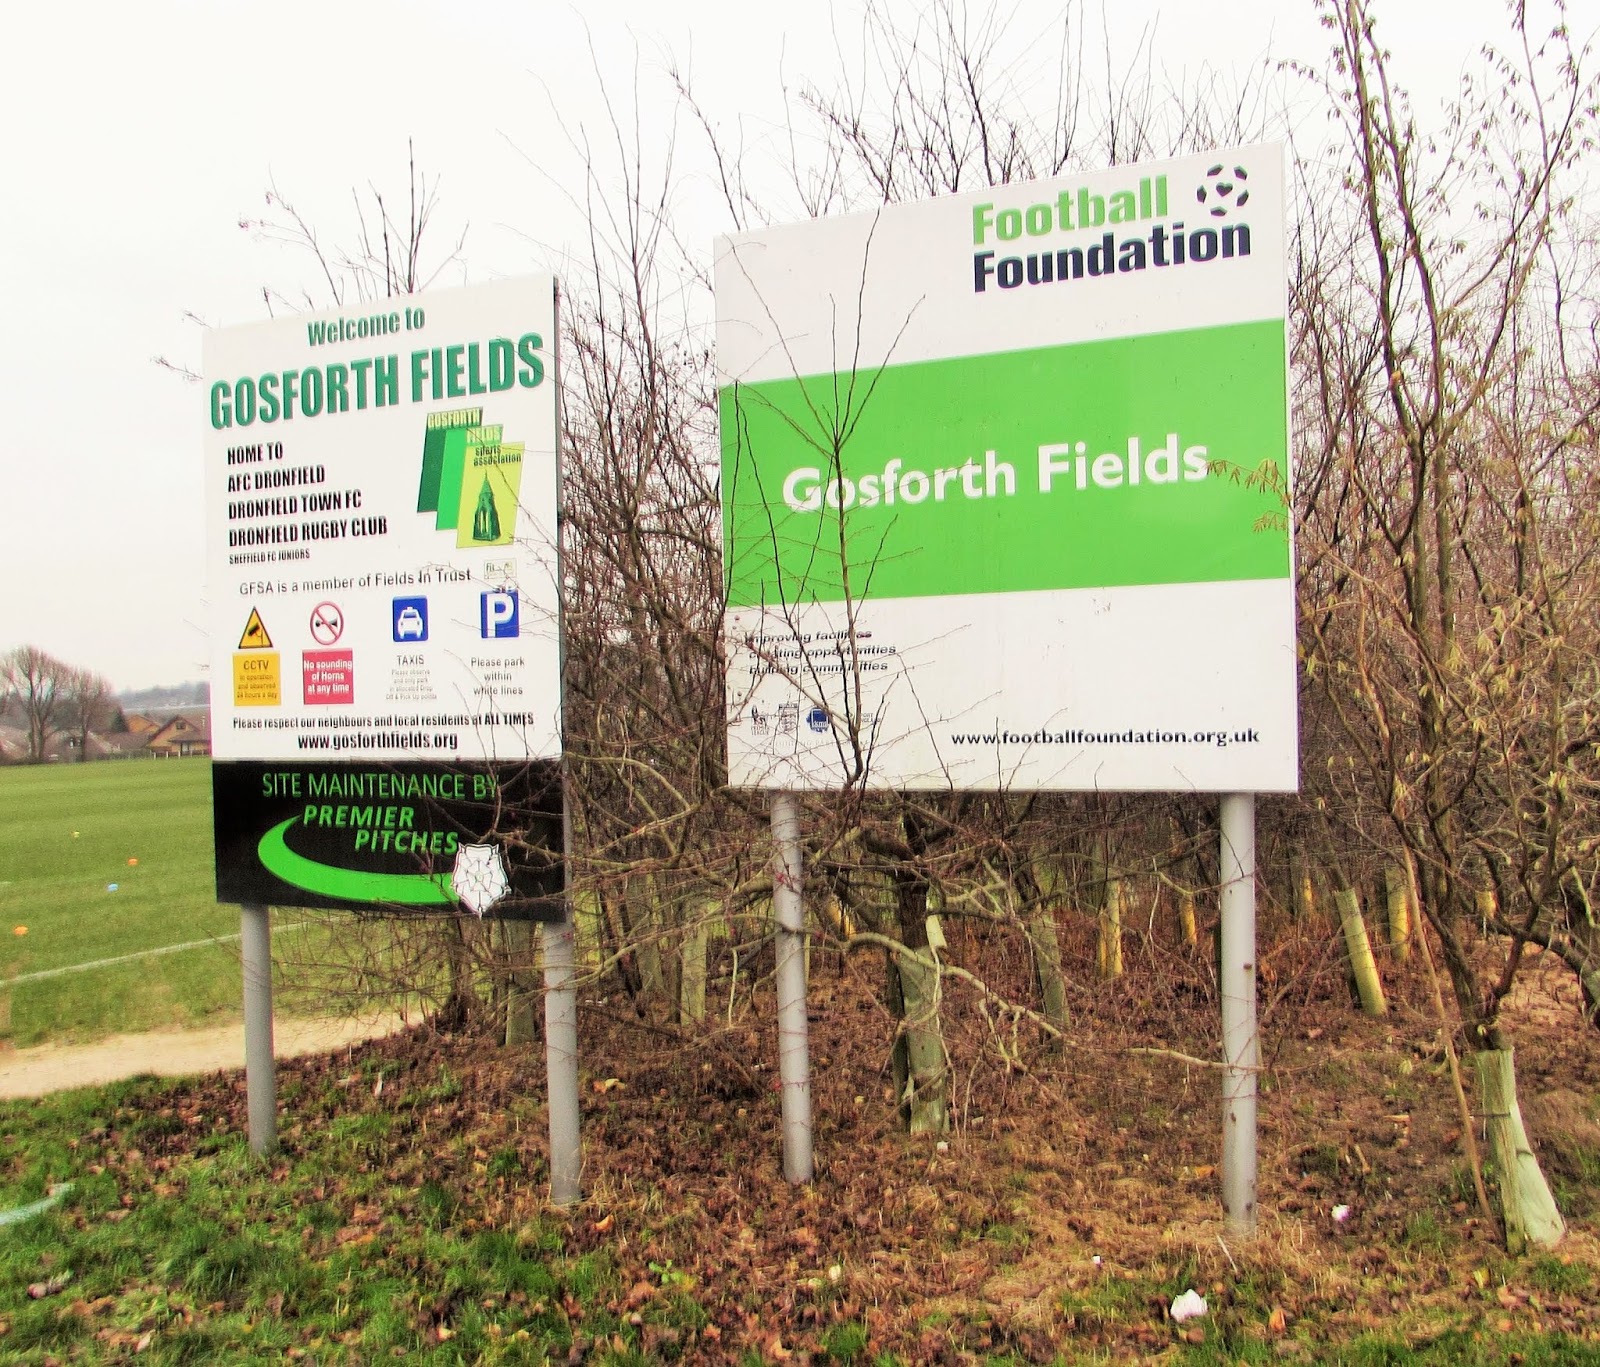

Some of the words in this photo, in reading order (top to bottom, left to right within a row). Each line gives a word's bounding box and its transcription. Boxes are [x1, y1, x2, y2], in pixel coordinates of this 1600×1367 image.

[972, 174, 1168, 246] Football
[974, 221, 1251, 293] Foundation
[307, 311, 401, 347] Welcome
[405, 306, 426, 331] to
[210, 353, 400, 431] GOSFORTH
[411, 332, 545, 403] FIELDS
[427, 407, 481, 429] GOSFORTH
[227, 444, 264, 465] HOME
[266, 441, 284, 460] TO
[473, 453, 522, 466] association
[228, 472, 251, 492] AFC
[254, 464, 326, 490] DRONFIELD
[782, 448, 1016, 514] Gosforth
[1037, 432, 1209, 493] Fields
[228, 495, 298, 520] DRONFIELD
[301, 491, 342, 513] TOWN
[345, 489, 362, 509] FC
[229, 523, 298, 547] DRONFIELD
[302, 519, 348, 541] RUGBY
[351, 515, 387, 537] CLUB
[229, 551, 266, 565] SHEFFIELD
[267, 551, 276, 562] FC
[278, 548, 310, 561] JUNIORS
[239, 581, 274, 595] GFSA
[277, 580, 287, 593] is
[292, 582, 298, 592] a
[302, 576, 354, 592] member
[360, 575, 371, 588] of
[375, 572, 414, 586] Fields
[435, 568, 472, 583] Trust
[487, 592, 515, 638] P
[243, 660, 270, 671] CCTV
[304, 660, 314, 669] No
[316, 659, 353, 672] sounding
[397, 654, 425, 665] TAXIS
[471, 657, 501, 667] Please
[504, 656, 525, 668] park
[312, 672, 319, 681] of
[321, 671, 345, 681] Horns
[483, 672, 512, 681] within
[308, 684, 315, 693] at
[317, 685, 330, 695] any
[332, 683, 349, 693] time
[473, 686, 498, 695] white
[501, 686, 523, 695] lines
[233, 716, 262, 728] Please
[264, 716, 298, 730] respect
[301, 717, 315, 727] our
[318, 716, 372, 728] neighbours
[374, 714, 392, 727] and
[395, 714, 419, 726] local
[421, 713, 470, 726] residents
[472, 714, 482, 725] at
[484, 712, 500, 725] ALL
[503, 711, 534, 725] TIMES
[298, 730, 458, 751] www.gosforthfields.org
[951, 728, 1260, 747] www.footballfoundation.org.uk
[263, 773, 302, 797] SITE
[308, 773, 465, 799] MAINTENANCE
[473, 774, 499, 799] BY
[303, 805, 415, 829] PREMIER
[354, 829, 459, 854] PITCHES
